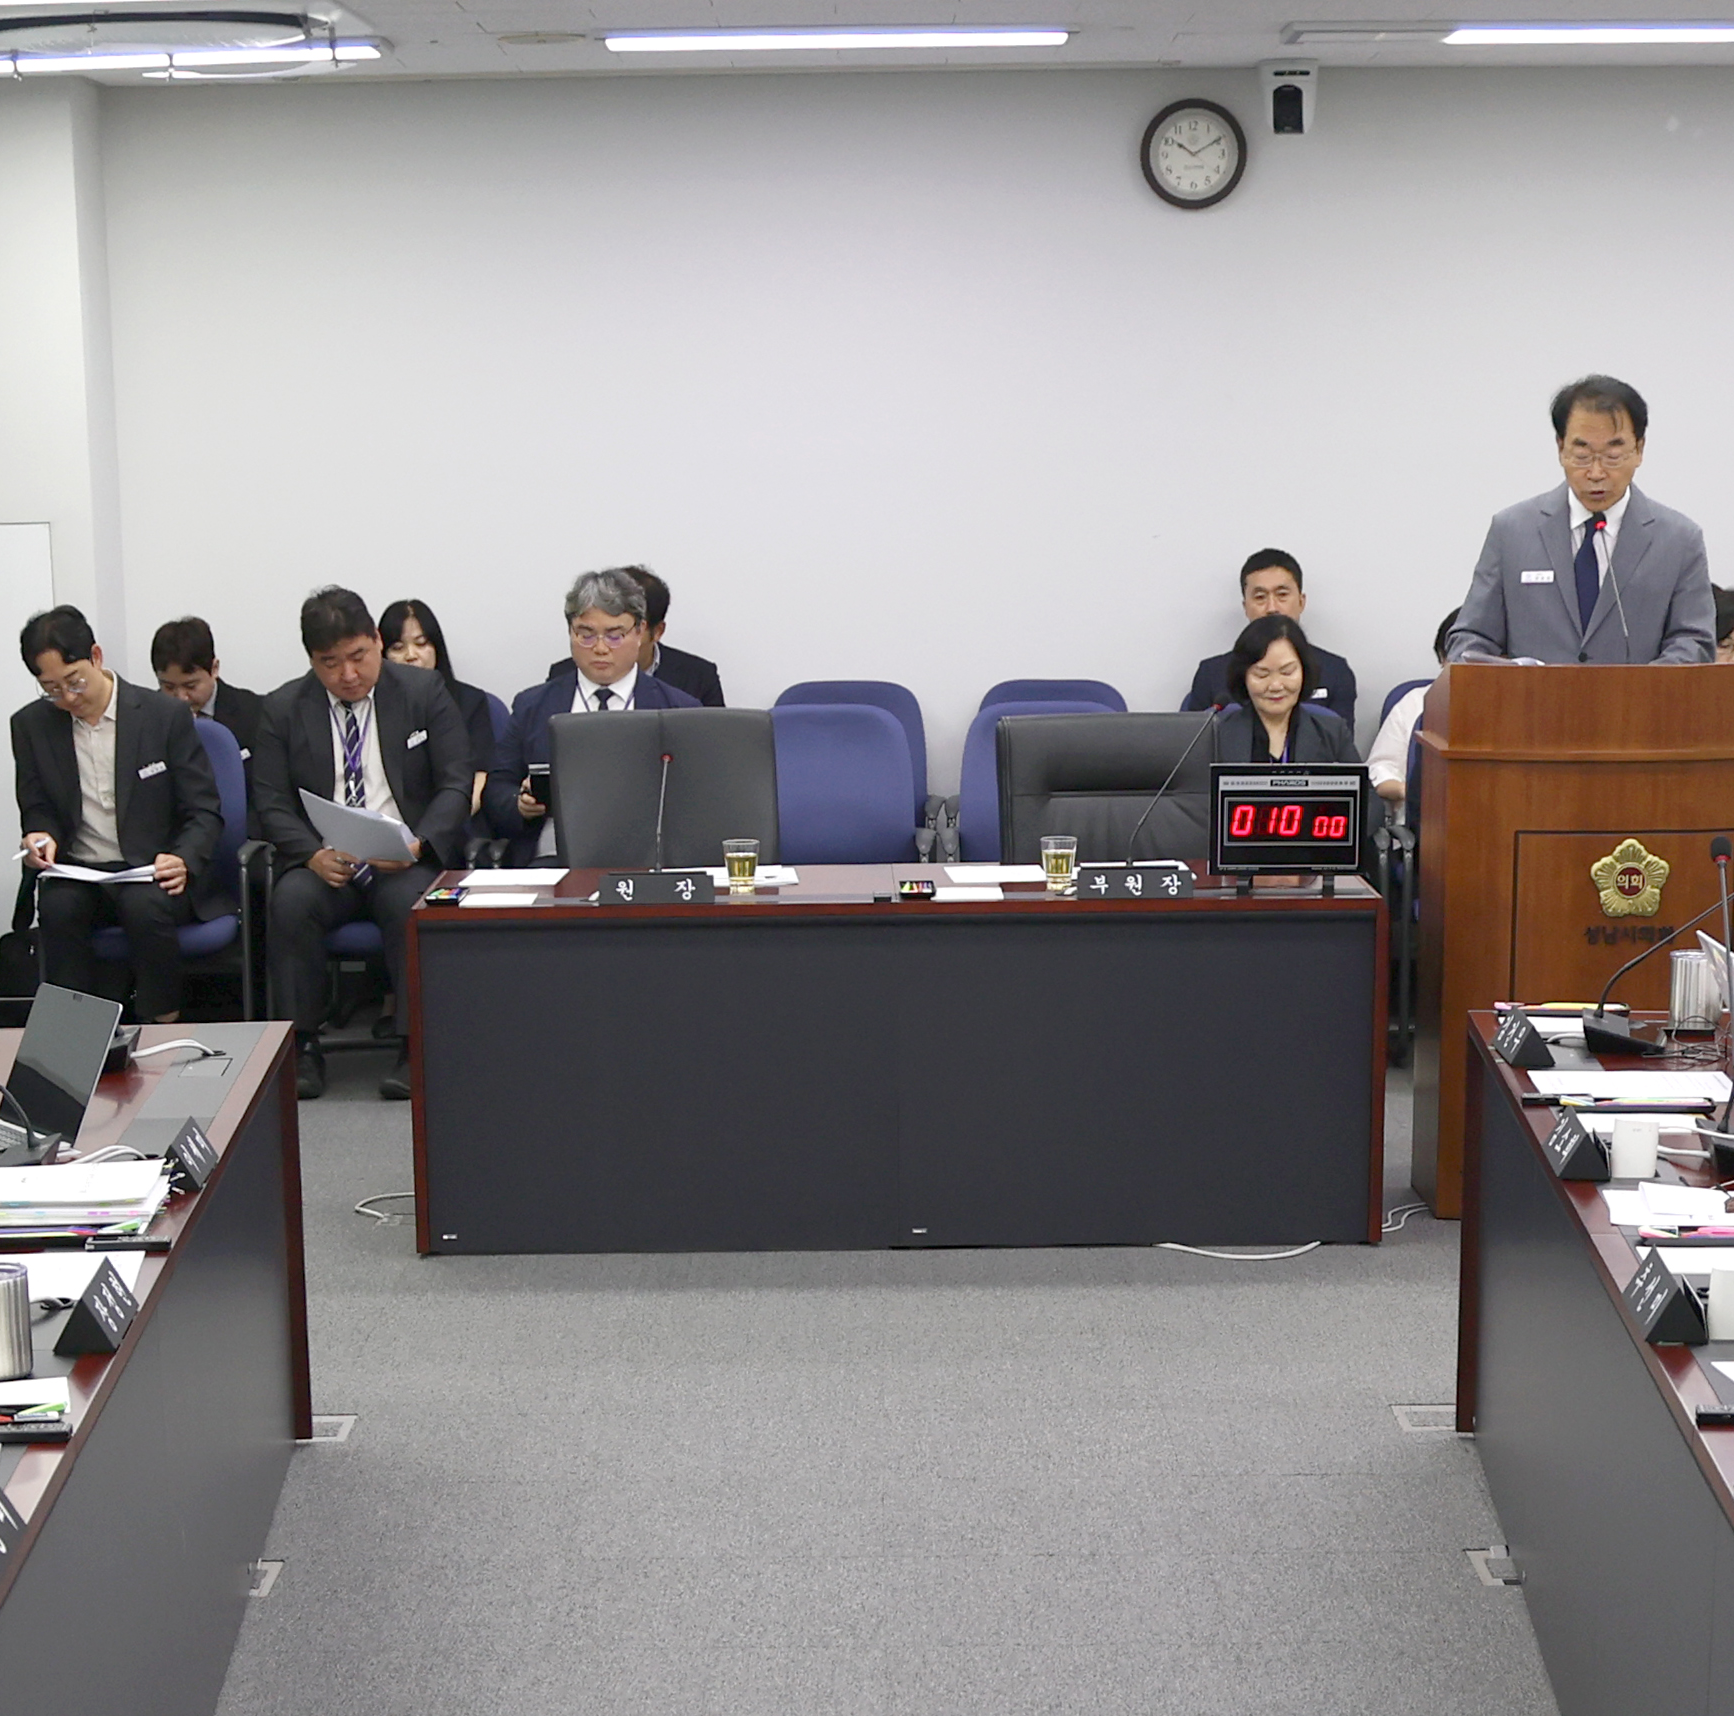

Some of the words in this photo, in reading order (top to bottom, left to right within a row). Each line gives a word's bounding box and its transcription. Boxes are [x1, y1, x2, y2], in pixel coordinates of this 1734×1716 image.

[1174, 125, 1183, 135] 11
[1188, 121, 1199, 131] 12
[1206, 124, 1211, 134] 1
[1163, 137, 1174, 147] 10
[1161, 151, 1169, 160] 9
[1218, 149, 1226, 159] 3
[1165, 166, 1173, 175] 8
[1214, 165, 1220, 175] 4
[1175, 176, 1182, 186] 7
[1190, 180, 1198, 190] 6
[1204, 175, 1211, 186] 5
[1312, 815, 1348, 838] 00
[1090, 874, 1181, 898] 부원장
[1617, 874, 1643, 890] 의회
[1585, 925, 1675, 945] 성남시의회
[1630, 1262, 1668, 1325] 추선미
